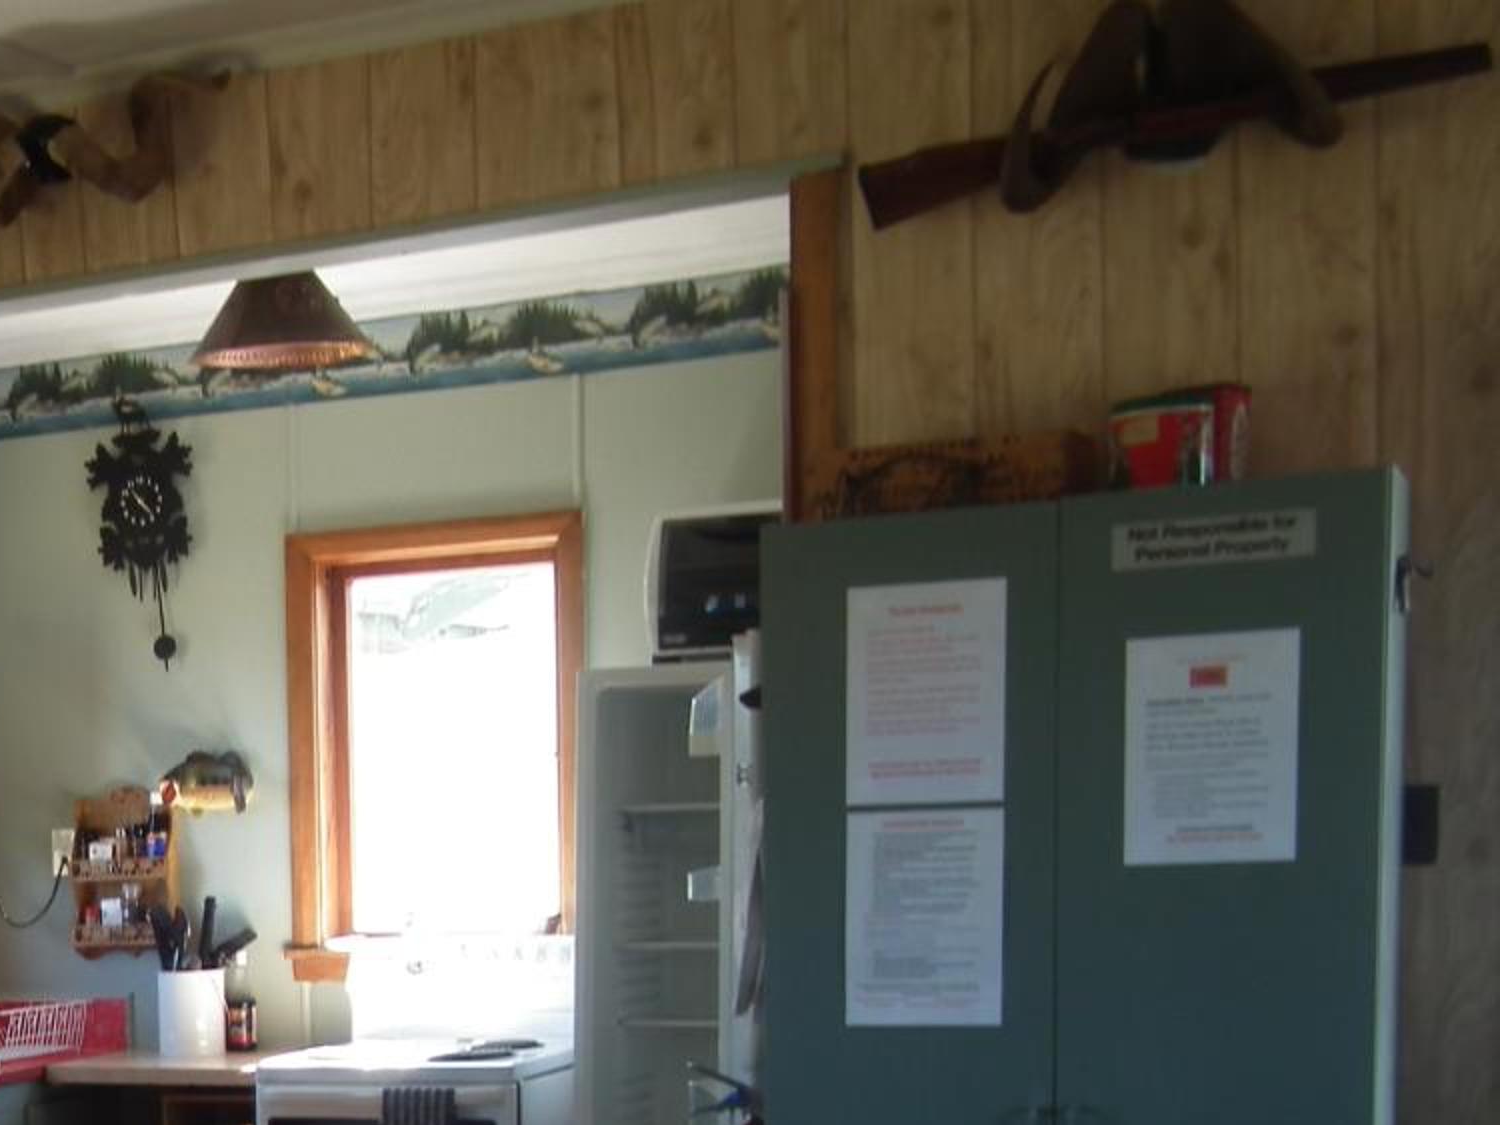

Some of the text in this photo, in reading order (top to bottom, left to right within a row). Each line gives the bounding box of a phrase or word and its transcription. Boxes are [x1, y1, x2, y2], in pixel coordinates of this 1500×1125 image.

[1128, 514, 1297, 541] Not Responsible for
[1134, 537, 1290, 562] Personal Property
